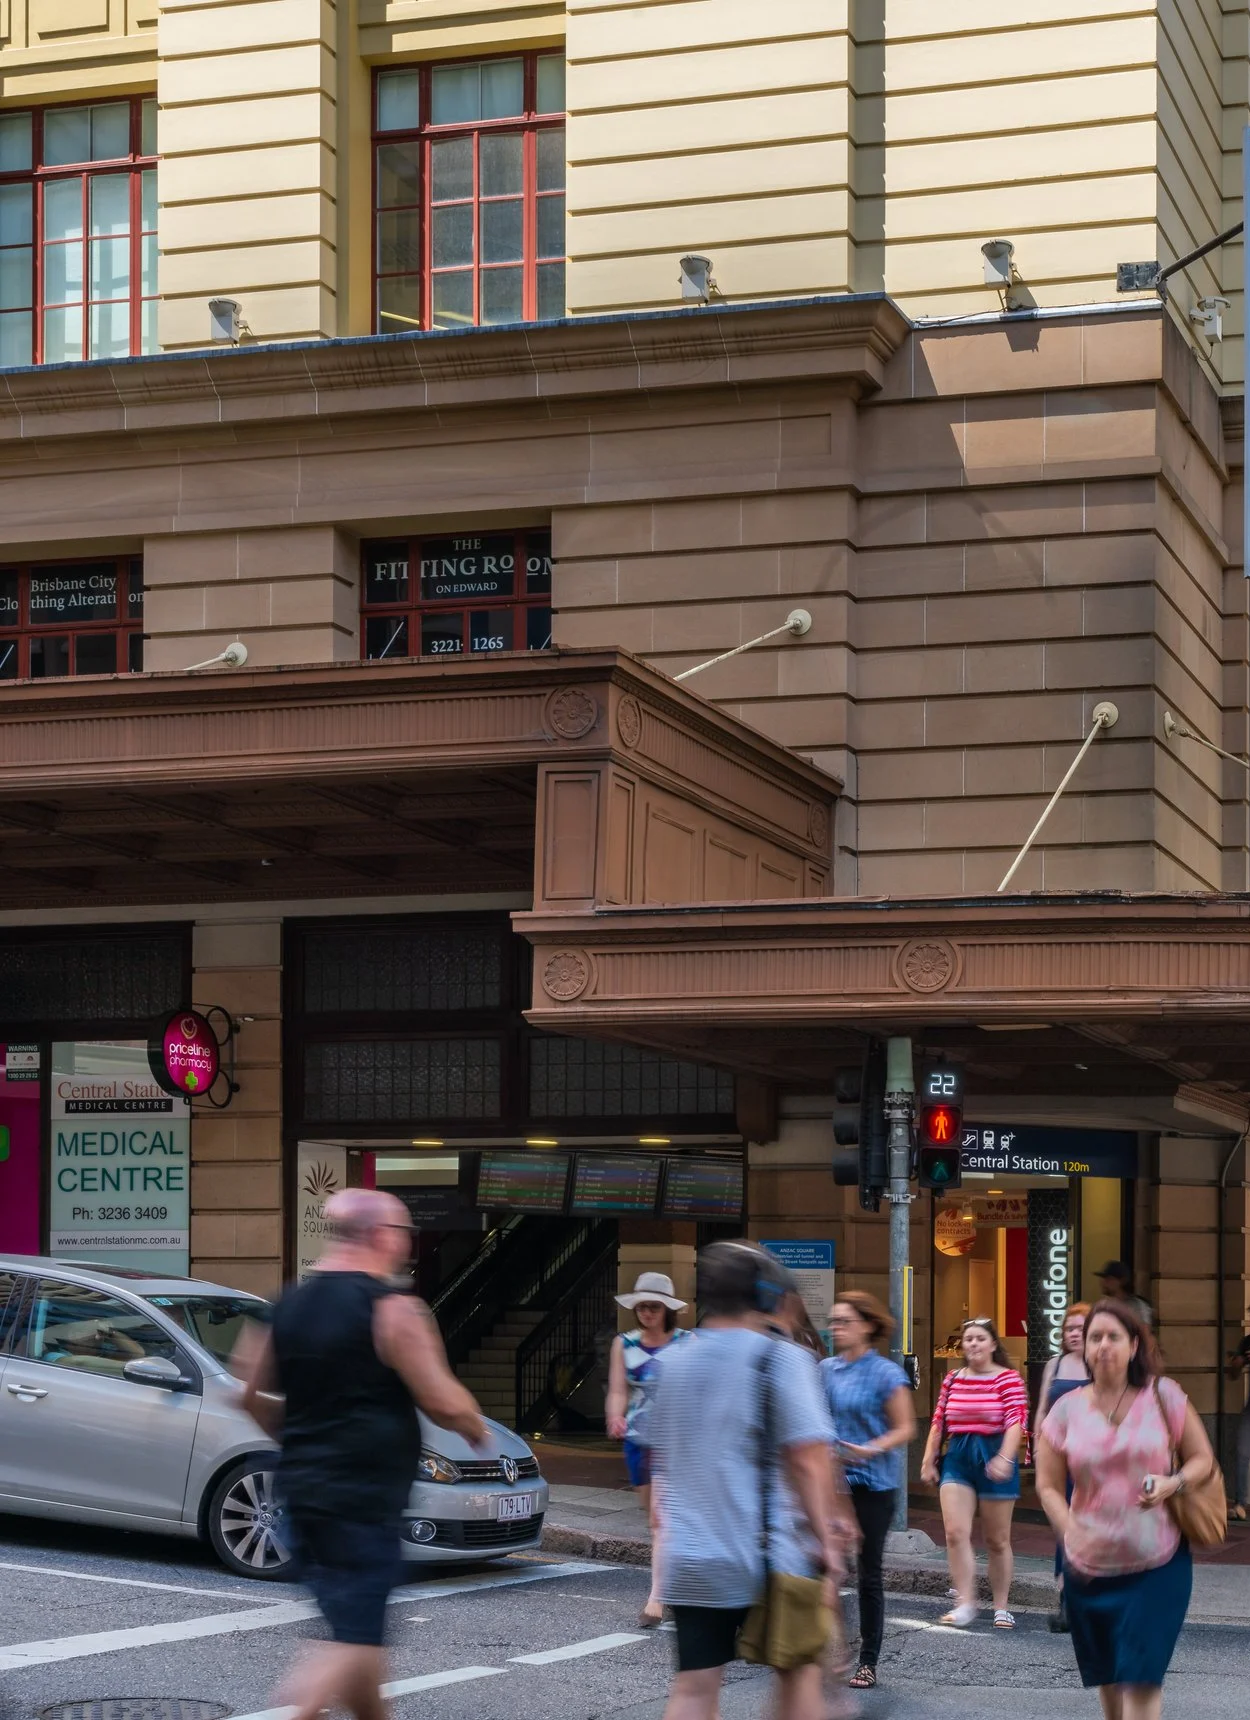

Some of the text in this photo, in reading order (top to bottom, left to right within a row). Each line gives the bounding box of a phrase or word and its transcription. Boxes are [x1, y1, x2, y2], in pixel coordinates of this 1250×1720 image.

[453, 538, 482, 551] THE
[374, 556, 478, 582] FITTING
[30, 575, 117, 592] Brisbane City
[435, 581, 498, 594] ON EDWARD
[67, 592, 144, 607] Alteration
[431, 636, 504, 653] 3221 1265
[169, 1043, 211, 1057] priceline
[169, 1056, 212, 1072] pharmacy
[57, 1080, 170, 1099] Central Statio
[930, 1073, 956, 1095] 22
[69, 1101, 167, 1110] MEDICAL CENTRE
[57, 1130, 184, 1156] MEDICAL
[961, 1153, 1090, 1172] Central Station 120m
[57, 1166, 184, 1192] CENTRE
[72, 1206, 168, 1220] Ph: 3236 3409
[1043, 1228, 1068, 1357] vodafone
